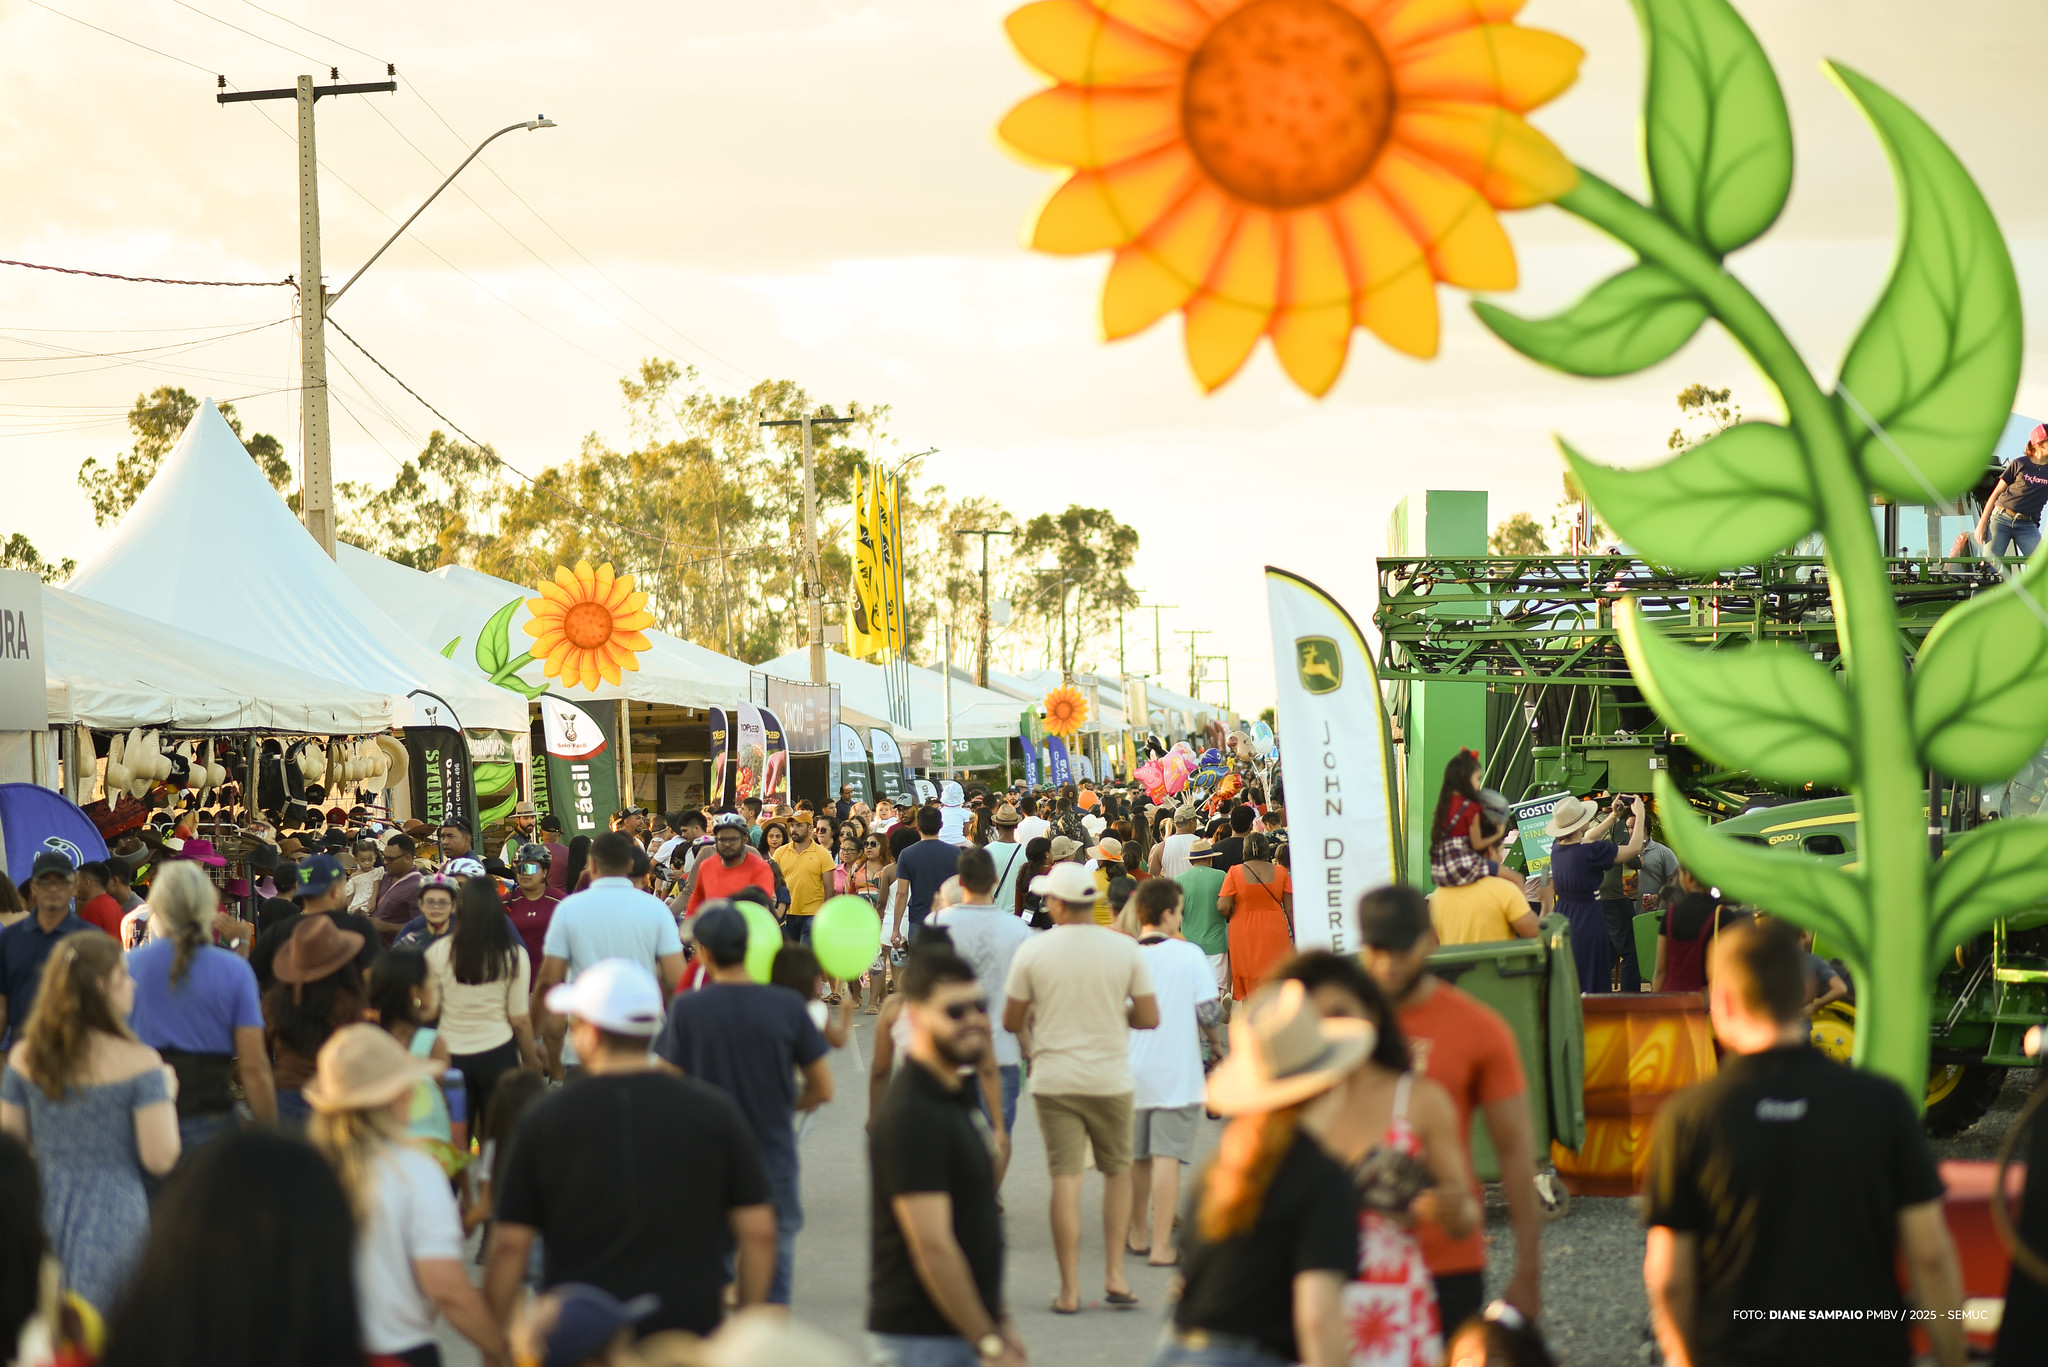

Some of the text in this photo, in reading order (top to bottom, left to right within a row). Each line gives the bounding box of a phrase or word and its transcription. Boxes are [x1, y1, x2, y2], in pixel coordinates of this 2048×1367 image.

[571, 764, 596, 830] Fácil
[1323, 720, 1343, 817] JOHN
[1324, 838, 1345, 954] DEERE
